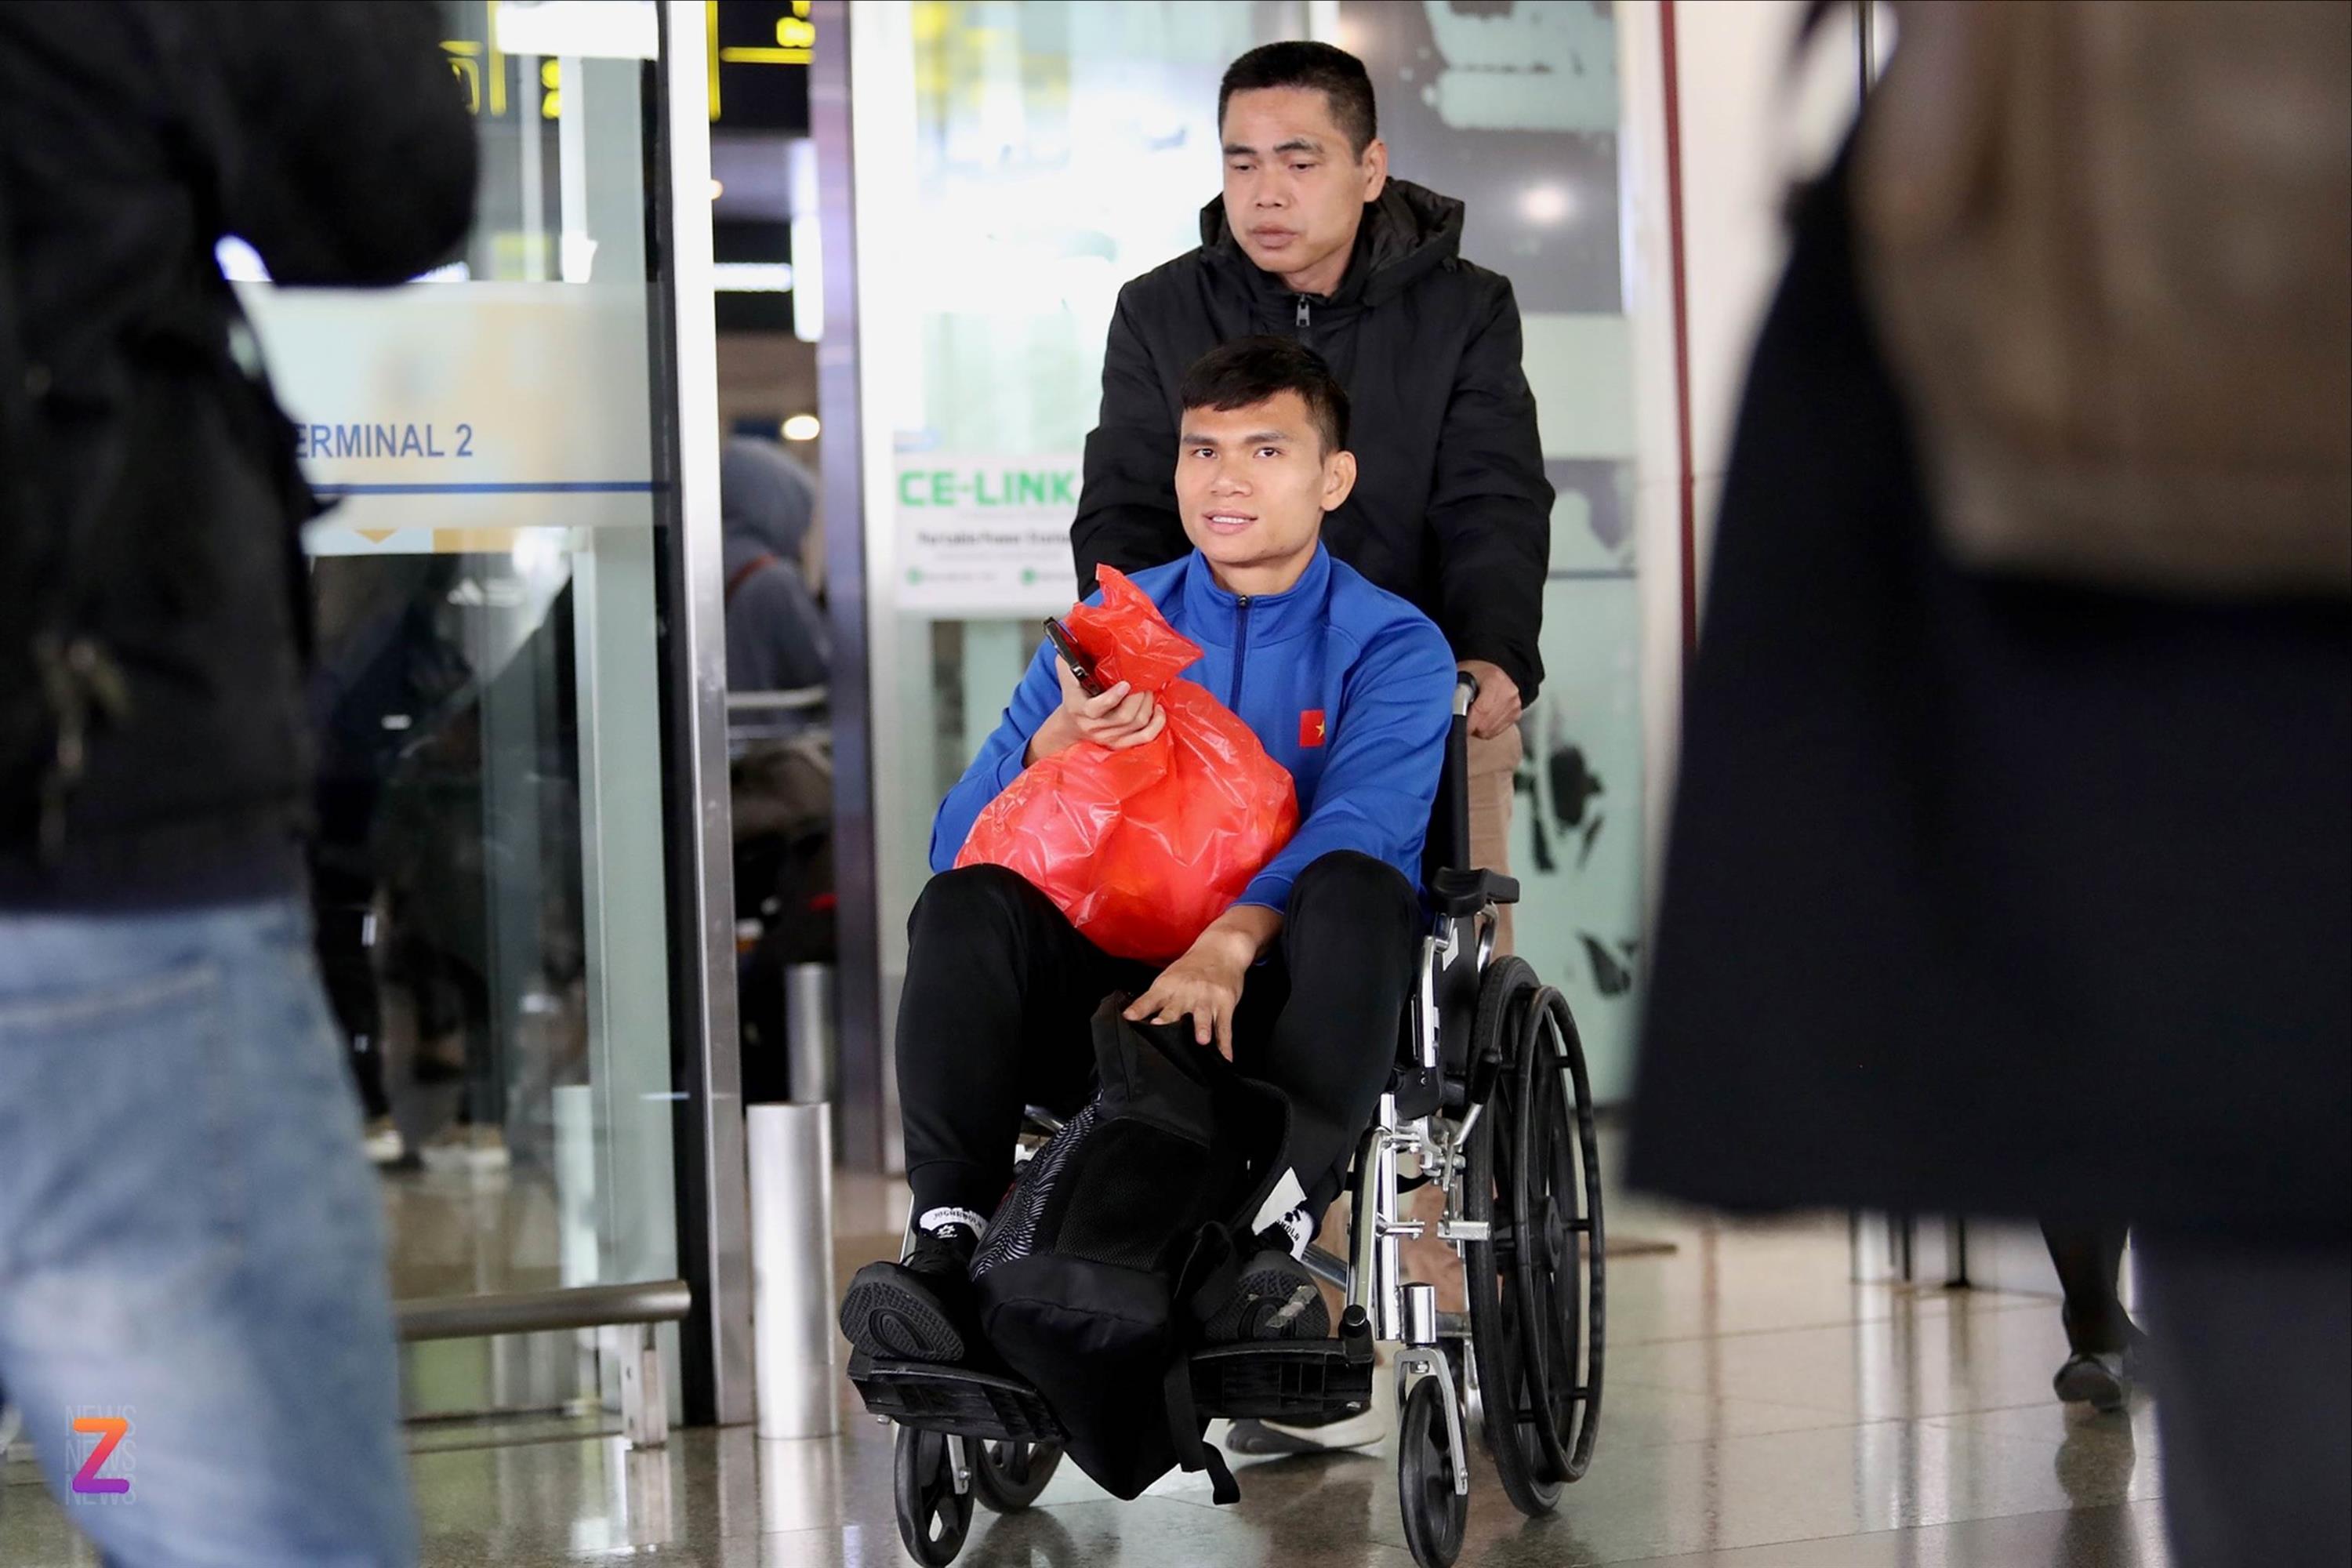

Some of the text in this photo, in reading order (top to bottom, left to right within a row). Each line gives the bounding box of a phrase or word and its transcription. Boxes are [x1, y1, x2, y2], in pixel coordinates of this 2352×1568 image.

[292, 423, 474, 458] ERMINAL 2
[898, 470, 1076, 506] CE-LINK
